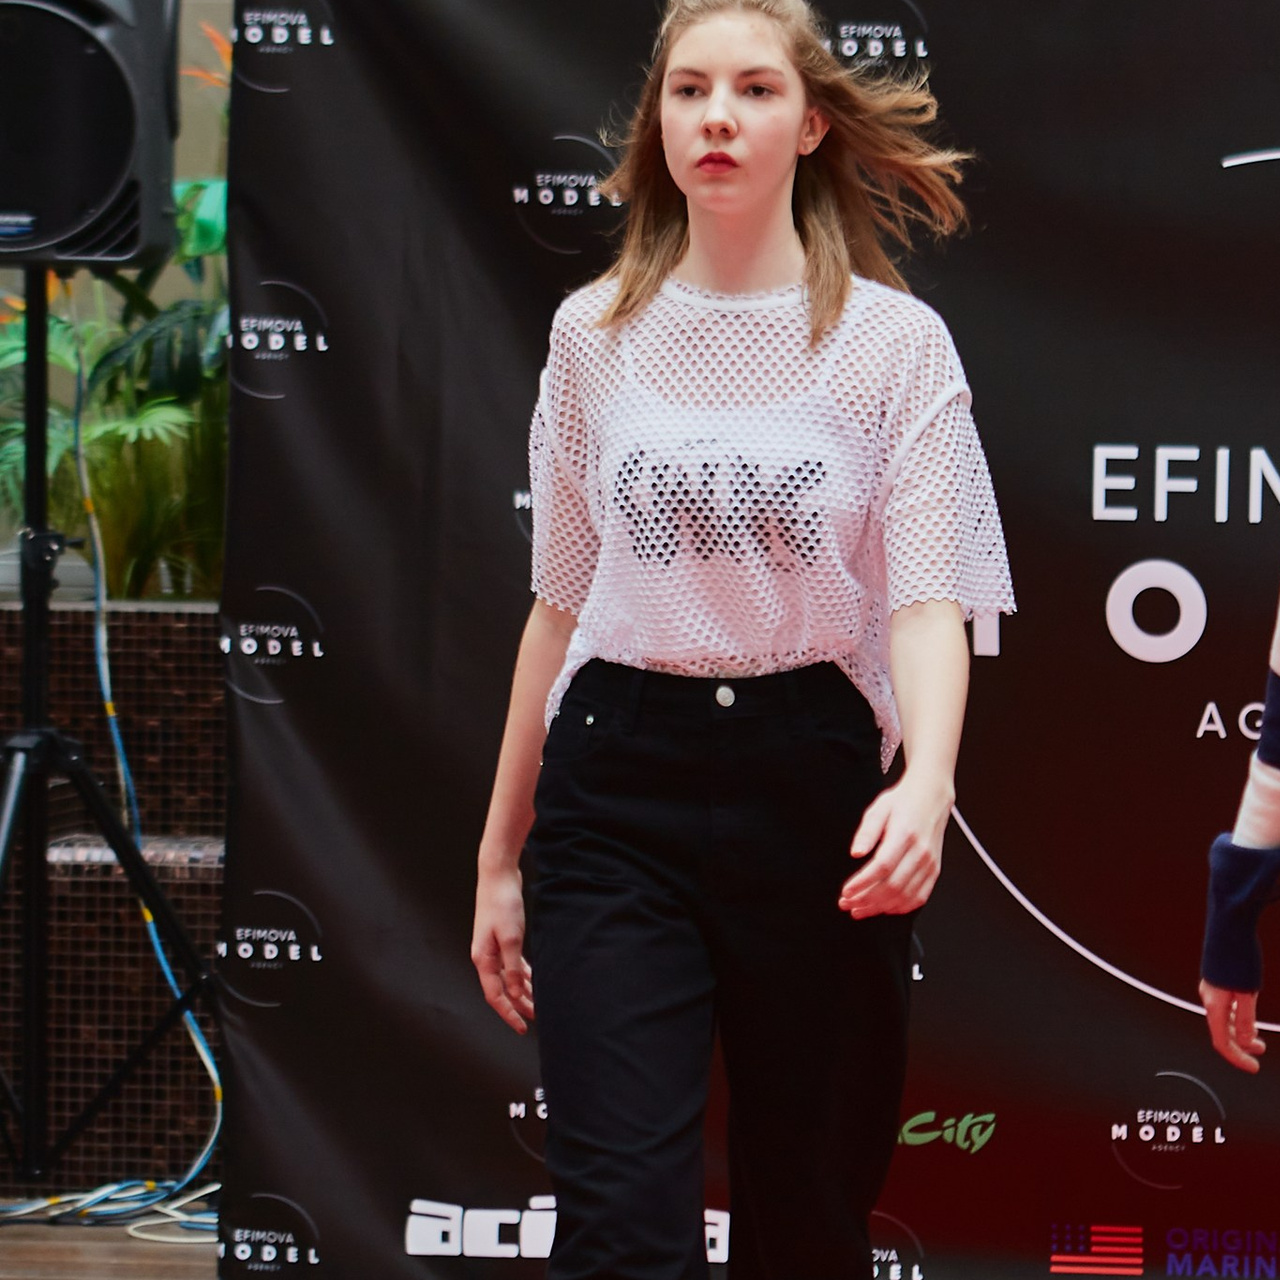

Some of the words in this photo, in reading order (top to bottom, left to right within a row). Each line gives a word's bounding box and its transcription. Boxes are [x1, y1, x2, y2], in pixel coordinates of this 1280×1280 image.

[243, 11, 308, 26] EFIMOVA
[840, 25, 902, 39] EFIMOVA
[536, 174, 598, 188] EFIMOVA
[241, 318, 303, 332] EFIMOVA
[239, 624, 299, 638] EFIMOVA
[235, 928, 297, 942] EFIMOVA
[1137, 1109, 1200, 1123] EFIMOVA
[900, 1111, 996, 1154] City
[1111, 1124, 1226, 1144] MODEL
[233, 1228, 294, 1242] EFIMOVA
